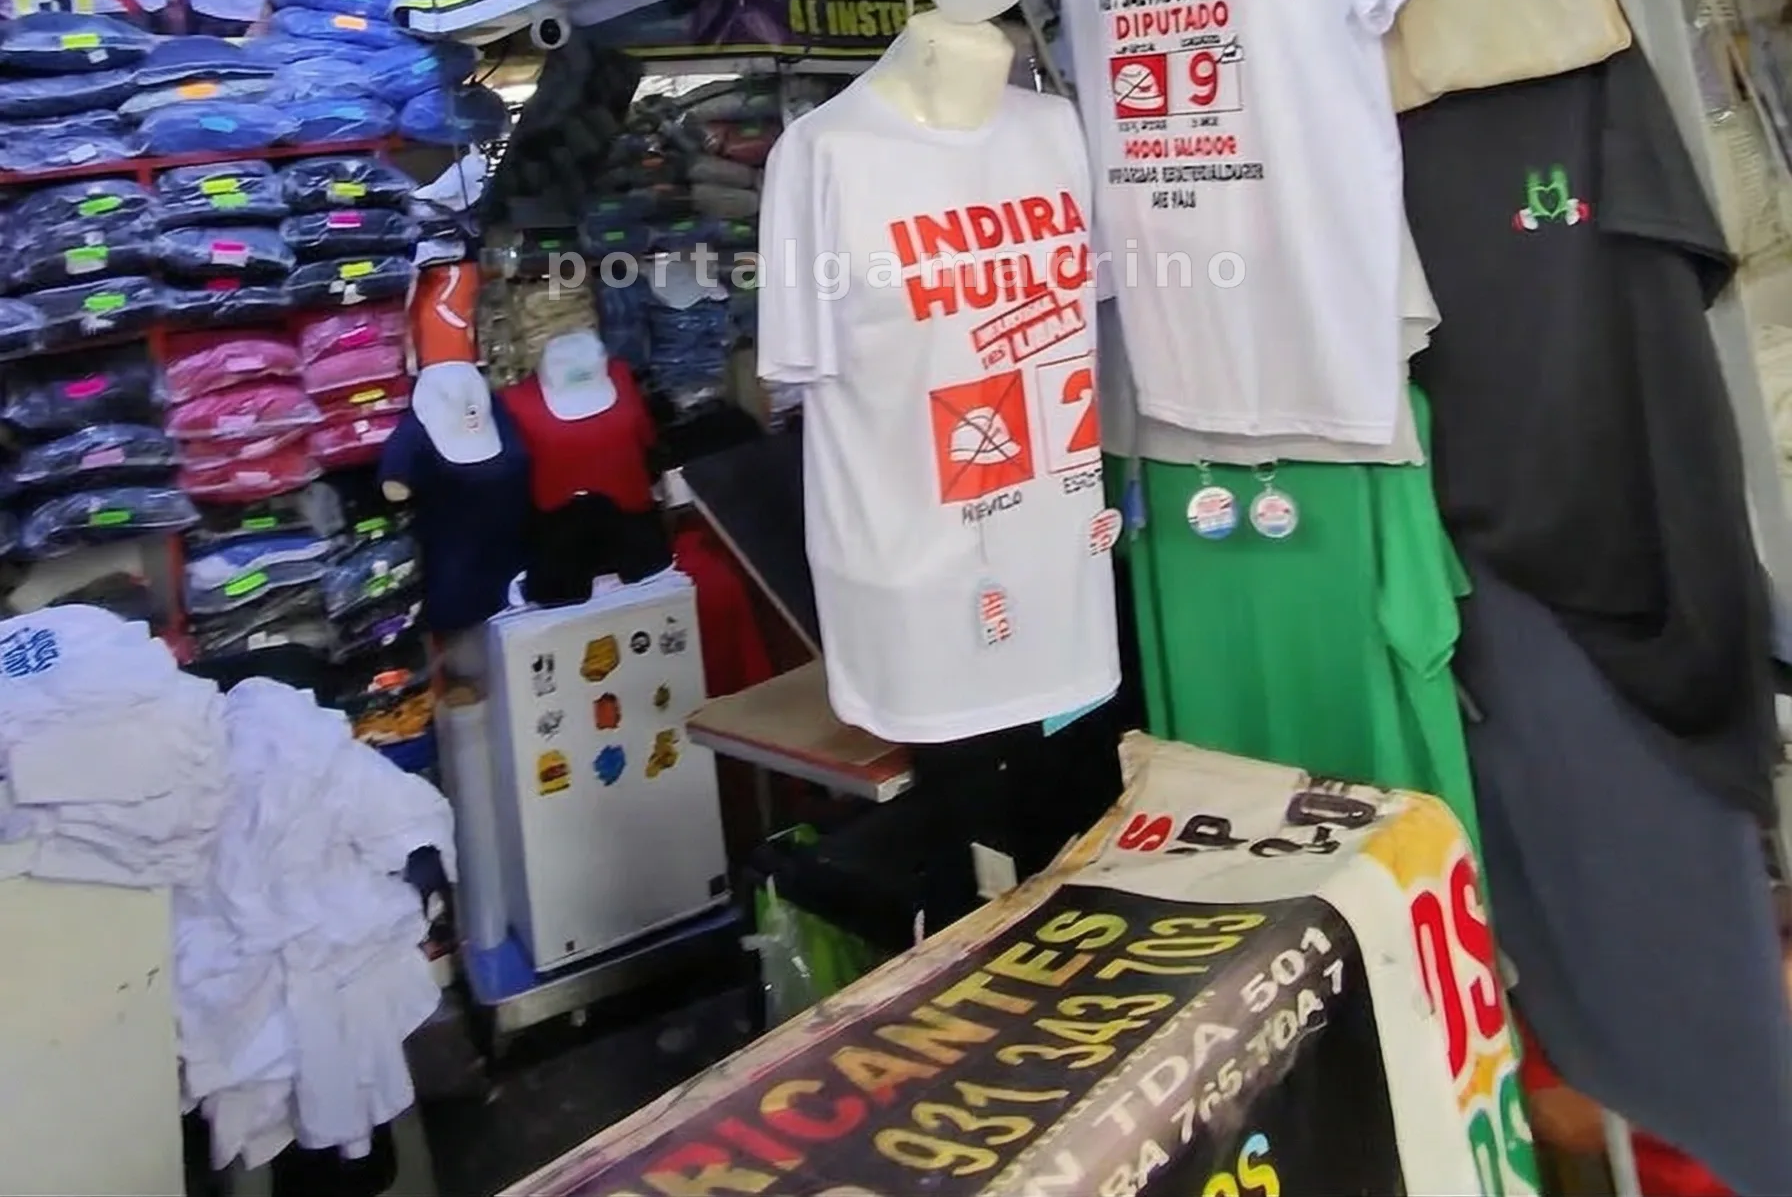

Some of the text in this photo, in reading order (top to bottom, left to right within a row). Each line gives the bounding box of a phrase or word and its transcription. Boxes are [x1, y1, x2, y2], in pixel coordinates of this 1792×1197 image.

[1116, 0, 1229, 40] DIPUTADO
[1188, 51, 1219, 107] 9
[890, 191, 1088, 268] INDIRA
[608, 910, 1129, 1197] RICANTES
[873, 912, 1268, 1177] 931 343 703
[1092, 1022, 1240, 1136] TDA
[1239, 926, 1332, 1013] 501
